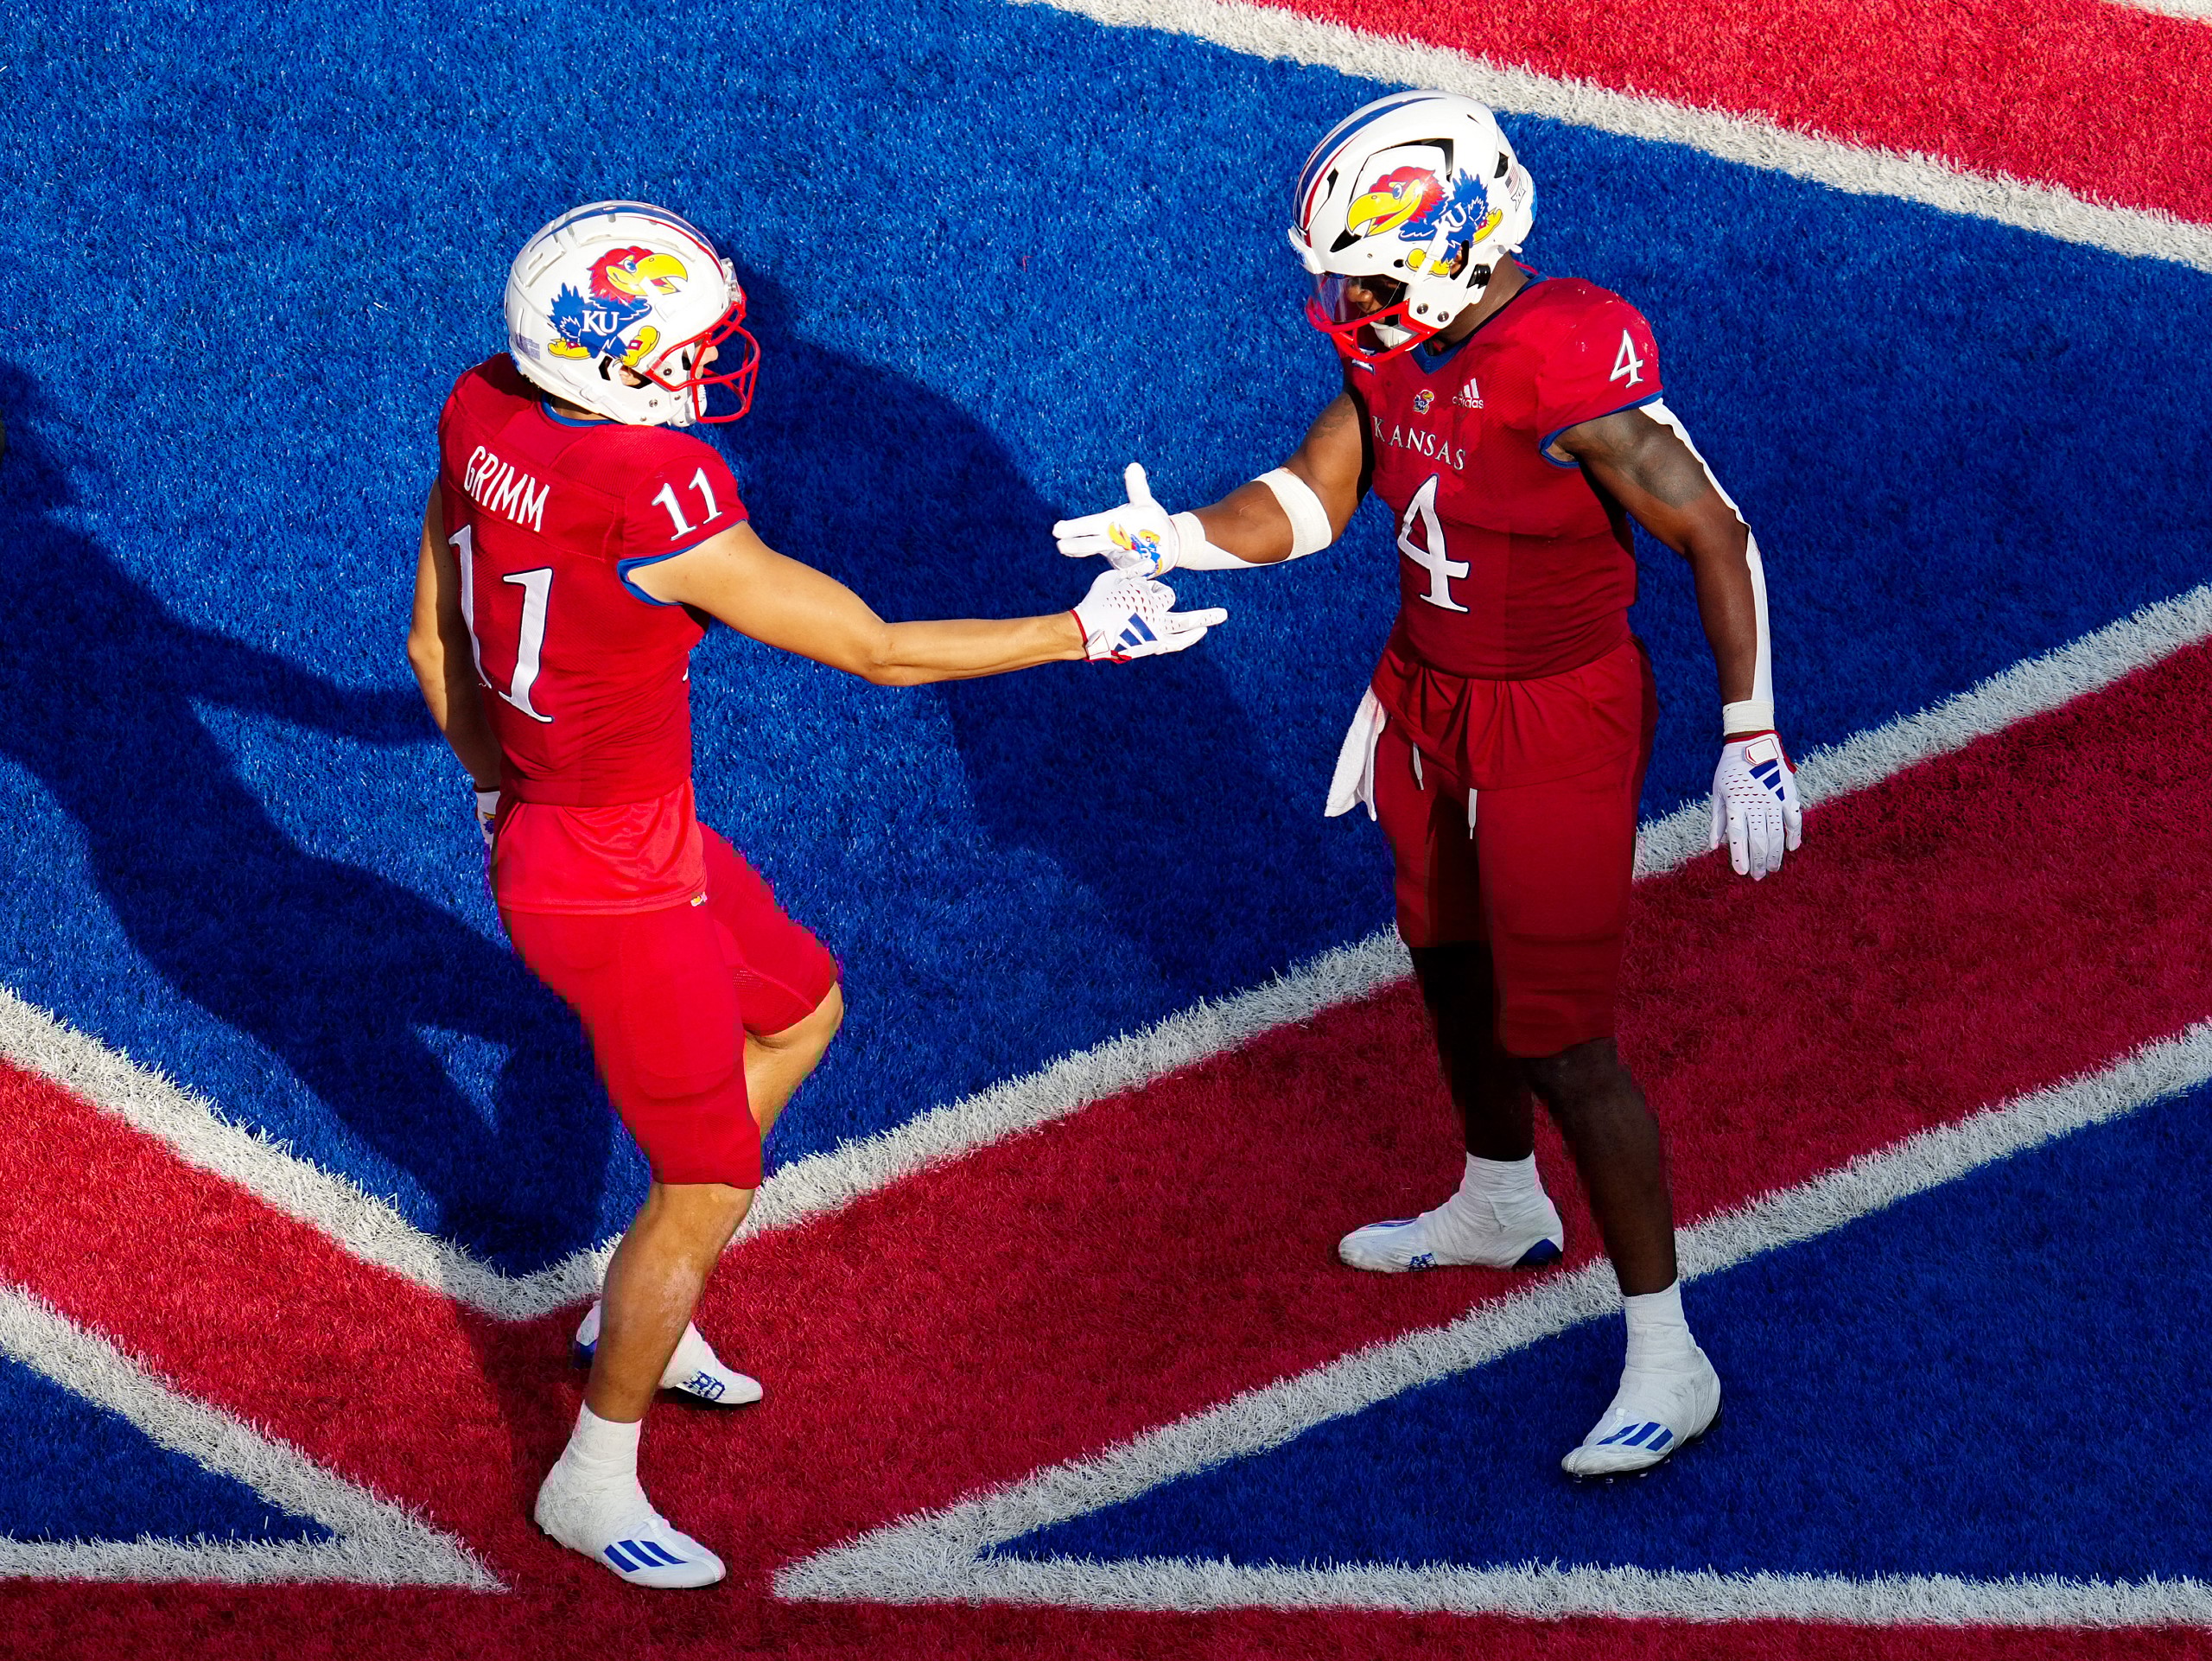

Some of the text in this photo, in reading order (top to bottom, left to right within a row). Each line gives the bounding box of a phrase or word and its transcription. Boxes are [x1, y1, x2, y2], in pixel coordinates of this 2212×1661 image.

[582, 309, 619, 336] KU
[1609, 328, 1644, 389] 4
[1452, 395, 1484, 409] adidas
[1372, 415, 1466, 471] KANSAS
[463, 445, 550, 533] GRIMM
[651, 467, 722, 541] 11
[1396, 473, 1471, 613] 4
[448, 524, 555, 722] 11
